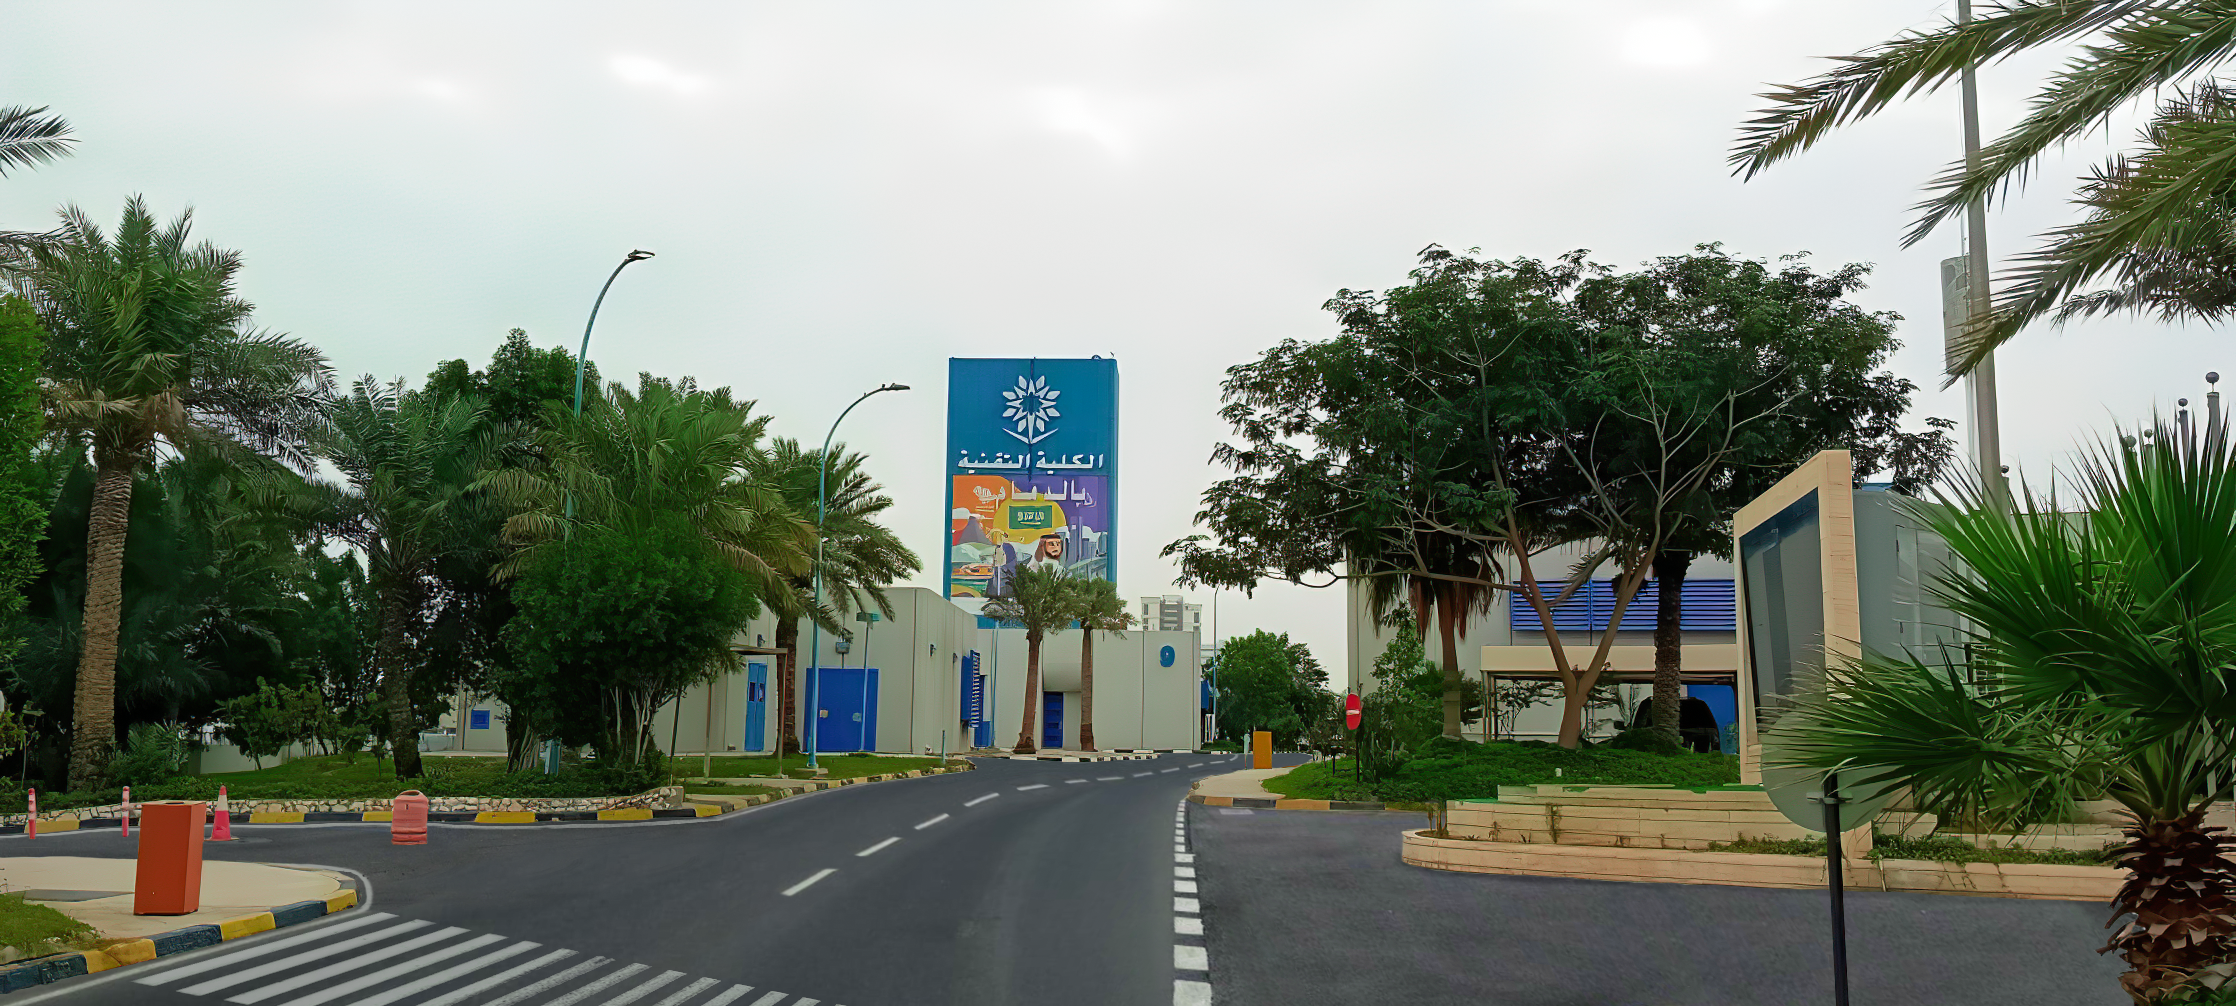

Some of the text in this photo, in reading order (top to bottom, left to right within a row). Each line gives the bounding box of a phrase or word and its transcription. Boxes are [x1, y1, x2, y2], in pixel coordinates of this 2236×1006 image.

[958, 449, 1103, 474] الكلية التقنية
[1160, 645, 1175, 668] 9
